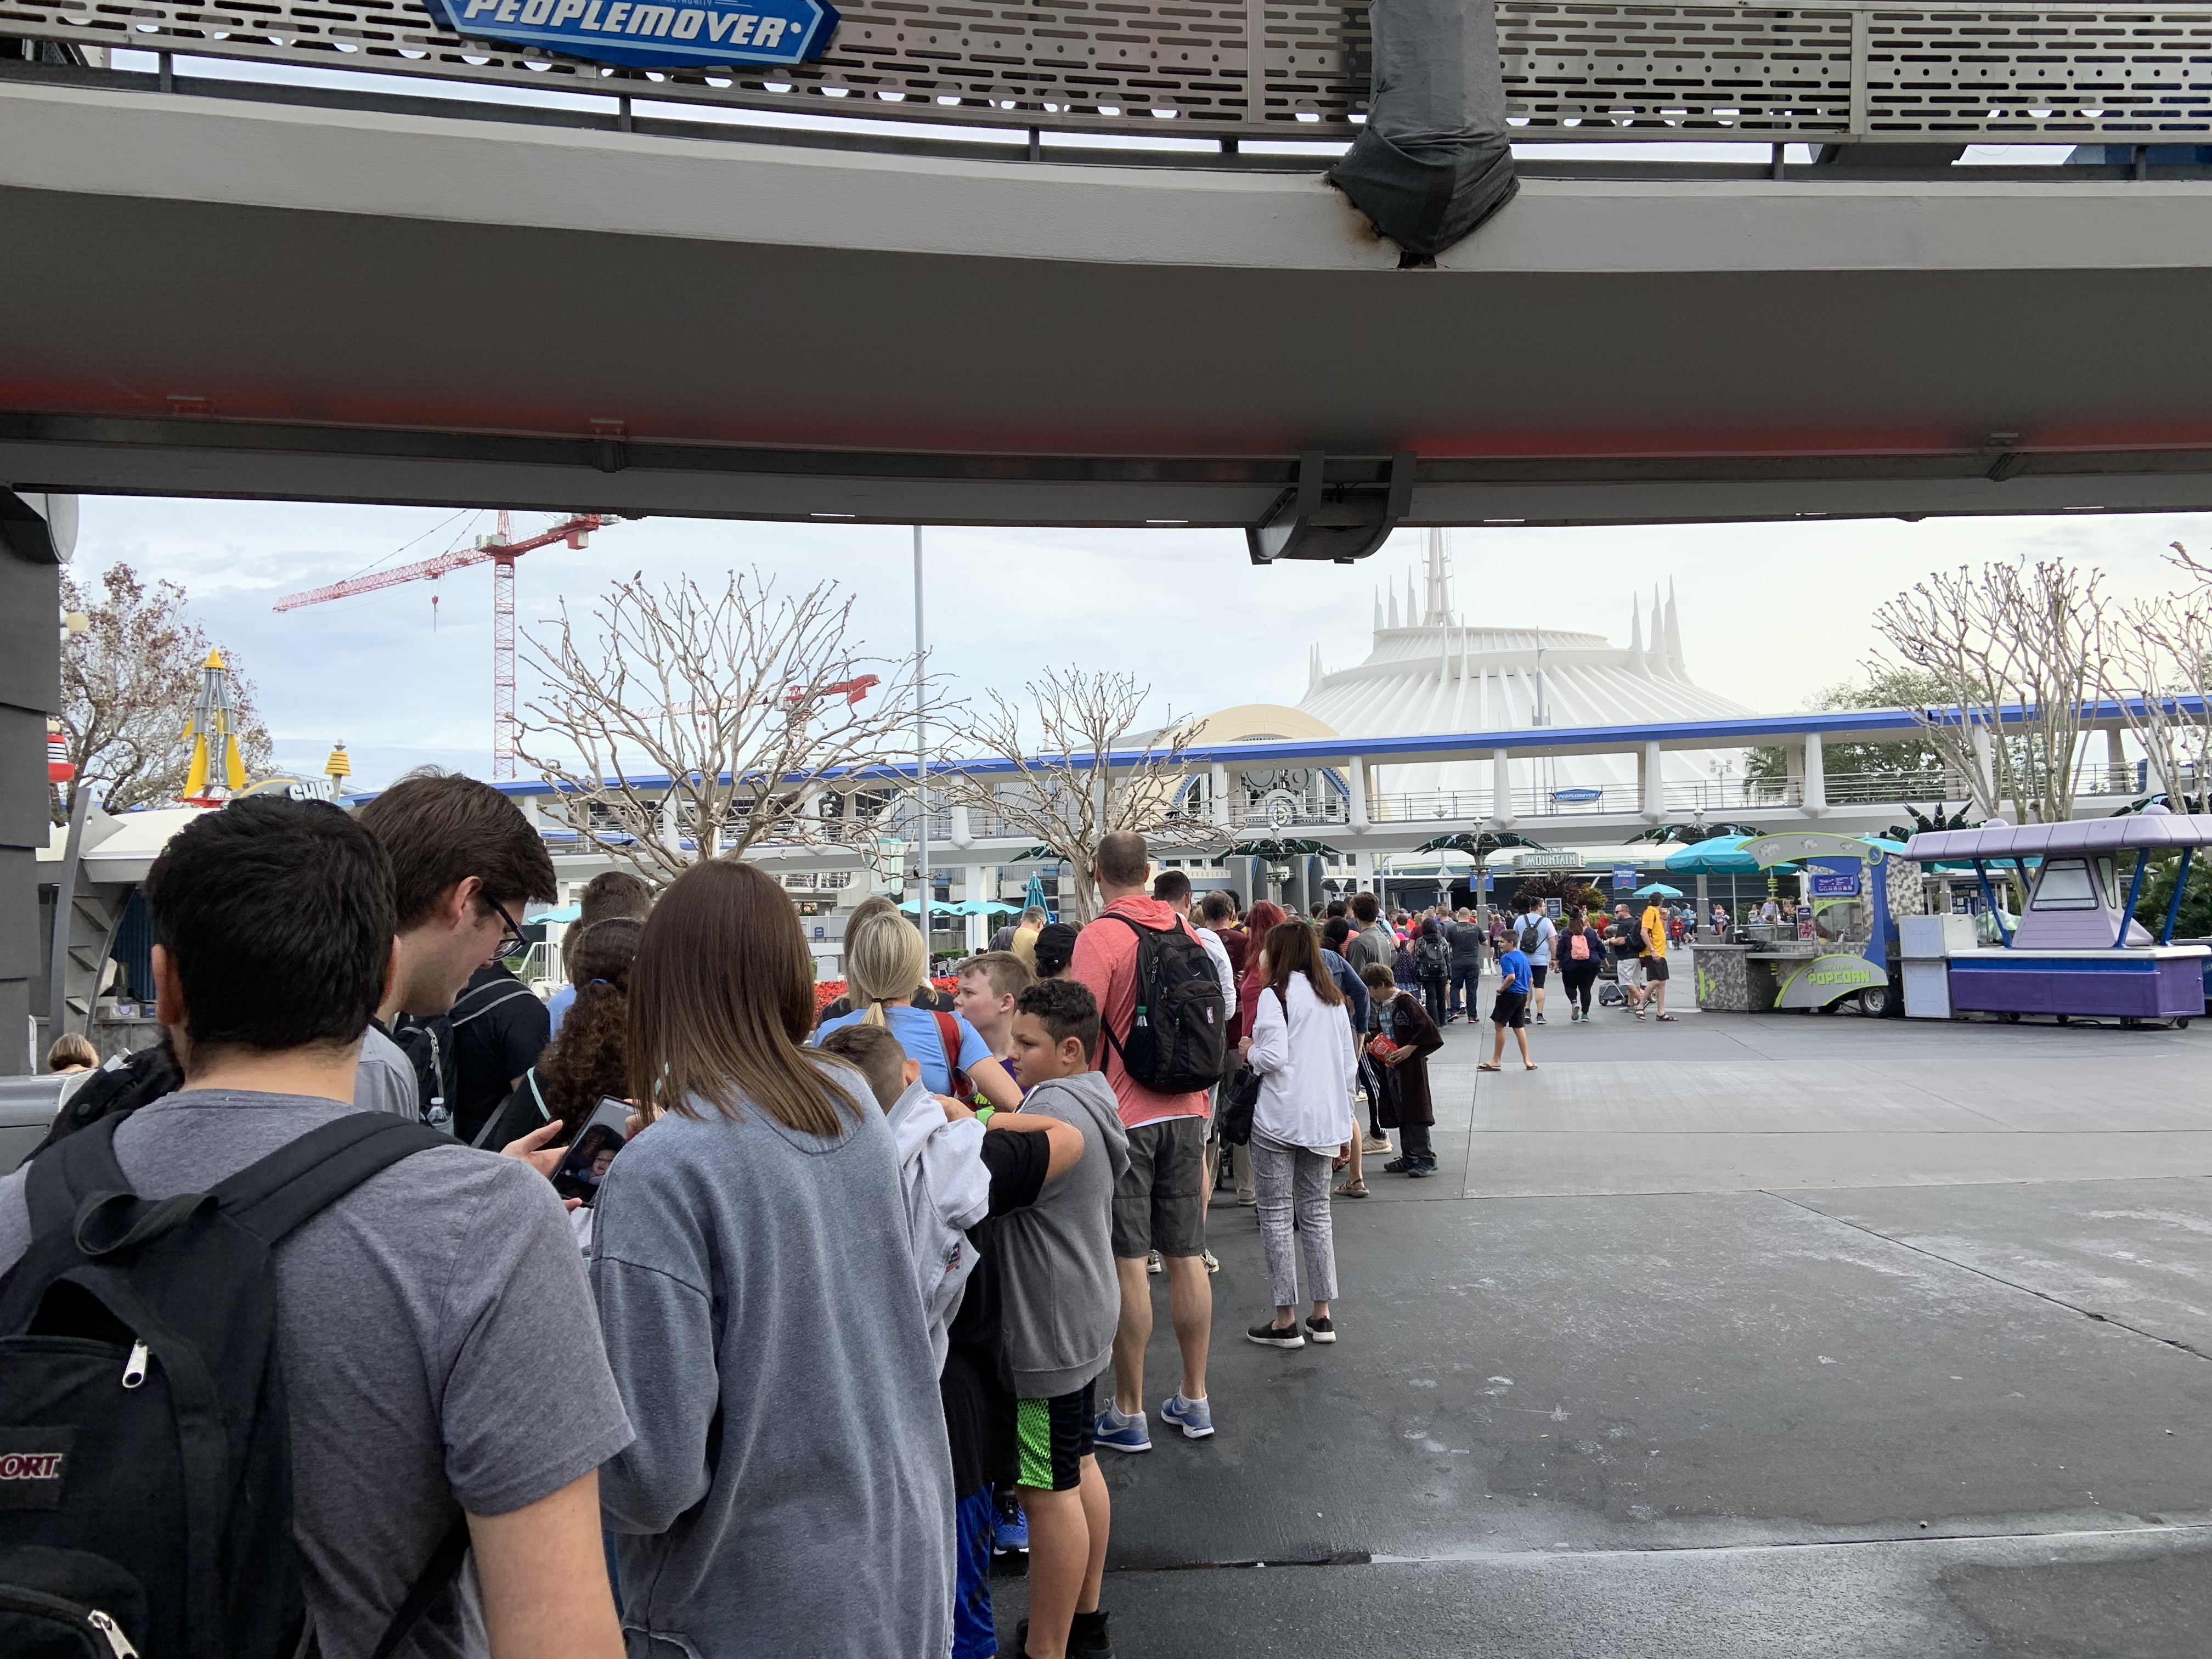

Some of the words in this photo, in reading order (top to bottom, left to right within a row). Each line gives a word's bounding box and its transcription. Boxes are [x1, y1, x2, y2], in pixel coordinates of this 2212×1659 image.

[464, 0, 787, 48] PEOPLEMOVER
[1526, 854, 1576, 867] MOUNTAIN
[1808, 970, 1871, 985] POPCORN
